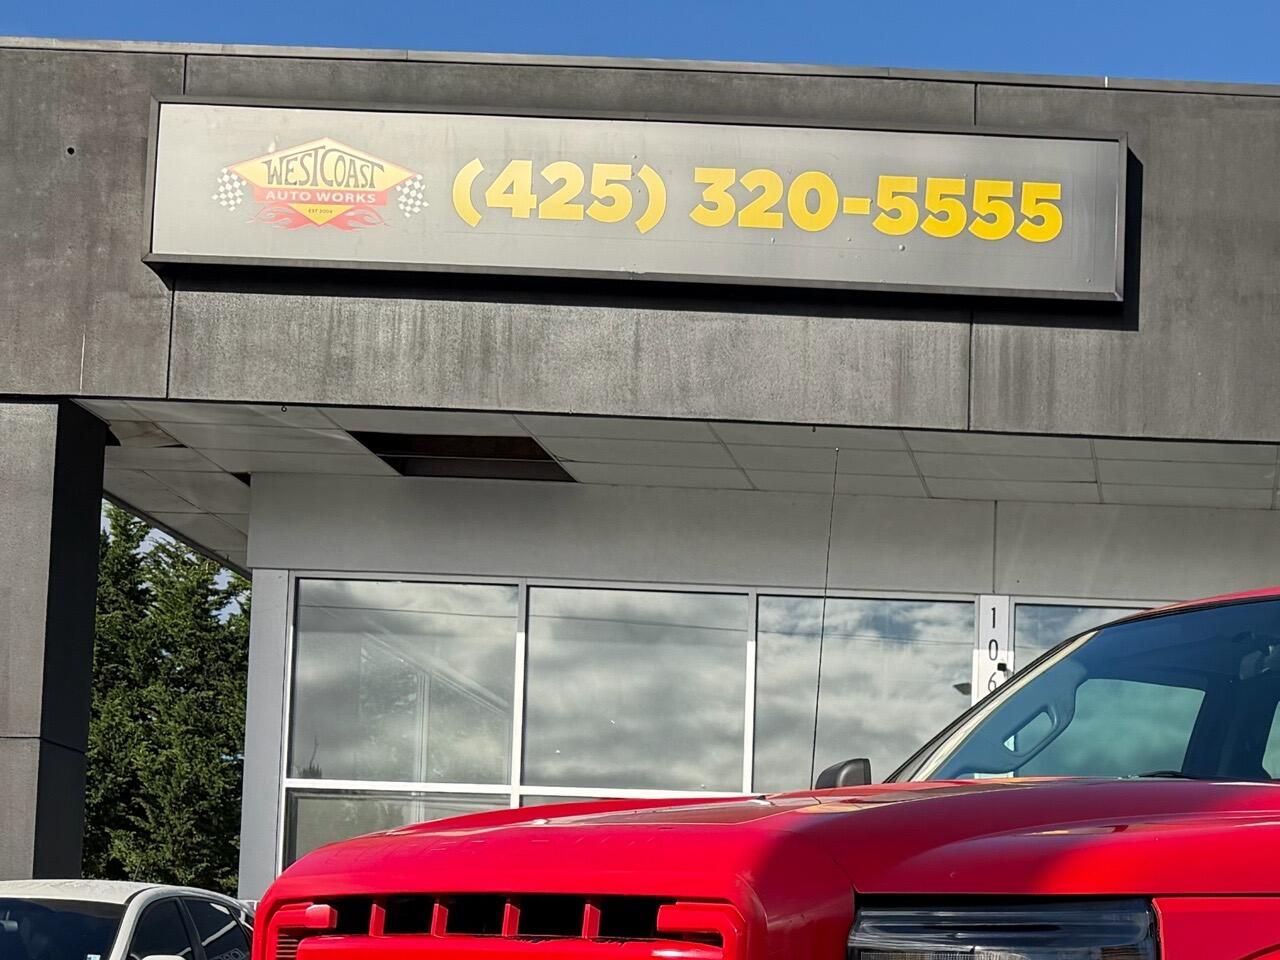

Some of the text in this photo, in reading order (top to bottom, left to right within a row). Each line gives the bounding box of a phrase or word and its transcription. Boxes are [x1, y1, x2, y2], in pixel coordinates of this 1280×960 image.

[265, 190, 376, 204] AUTO WORKS
[452, 157, 1063, 243] (425) 320-5555
